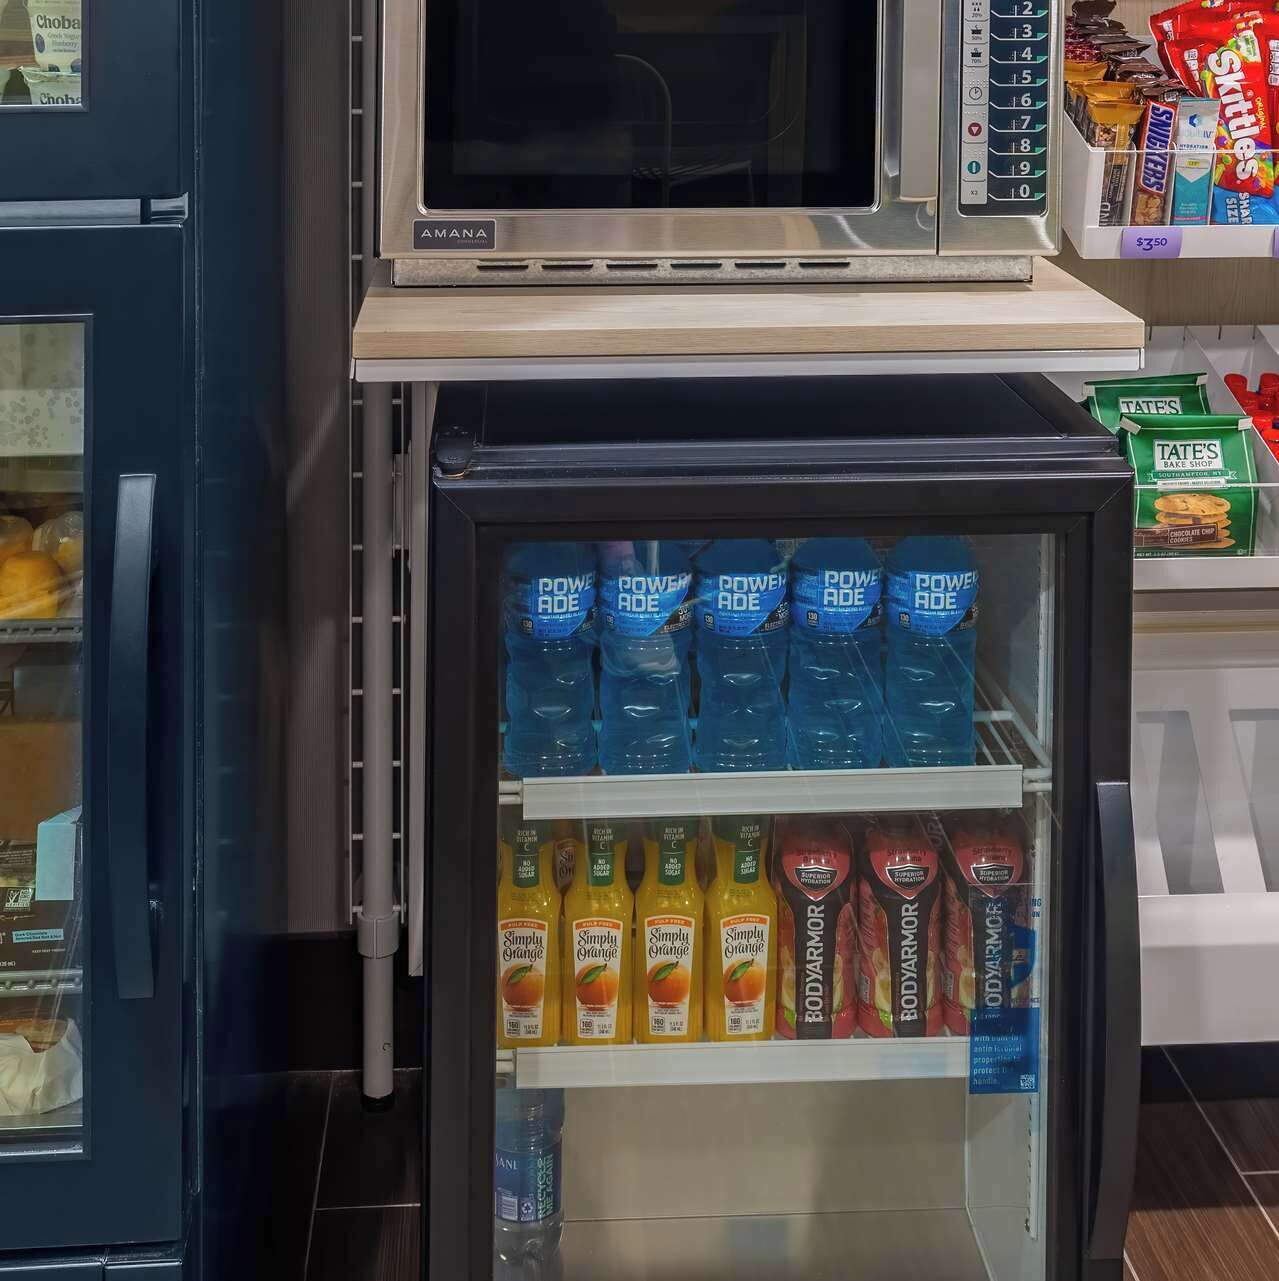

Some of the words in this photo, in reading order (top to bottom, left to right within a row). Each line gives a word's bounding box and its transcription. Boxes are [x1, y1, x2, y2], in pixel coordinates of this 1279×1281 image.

[1021, 47, 1032, 60] 4
[1021, 70, 1032, 83] 5
[1021, 93, 1032, 106] 6
[1021, 116, 1031, 129] 7
[1208, 47, 1259, 182] Skittles
[1020, 139, 1030, 152] 8
[1140, 103, 1176, 193] SNICKERS
[1020, 161, 1030, 174] 9
[421, 229, 488, 238] AMANA
[1156, 443, 1219, 461] TATE'S
[1169, 529, 1200, 538] CHOCOLATE
[1201, 527, 1215, 536] CHIP
[537, 595, 580, 613] ADE
[618, 593, 660, 612] ADE
[718, 592, 760, 611] ADE
[823, 588, 865, 606] ADE
[914, 592, 957, 609] ADE
[503, 930, 544, 949] Simply
[578, 930, 619, 948] Simply
[649, 927, 690, 945] Simply
[725, 926, 765, 944] Simply
[502, 945, 543, 962] Orange
[577, 945, 618, 961] Orange
[648, 943, 690, 959] Orange
[724, 942, 765, 959] Orange
[804, 903, 825, 1023] BODYARMOR
